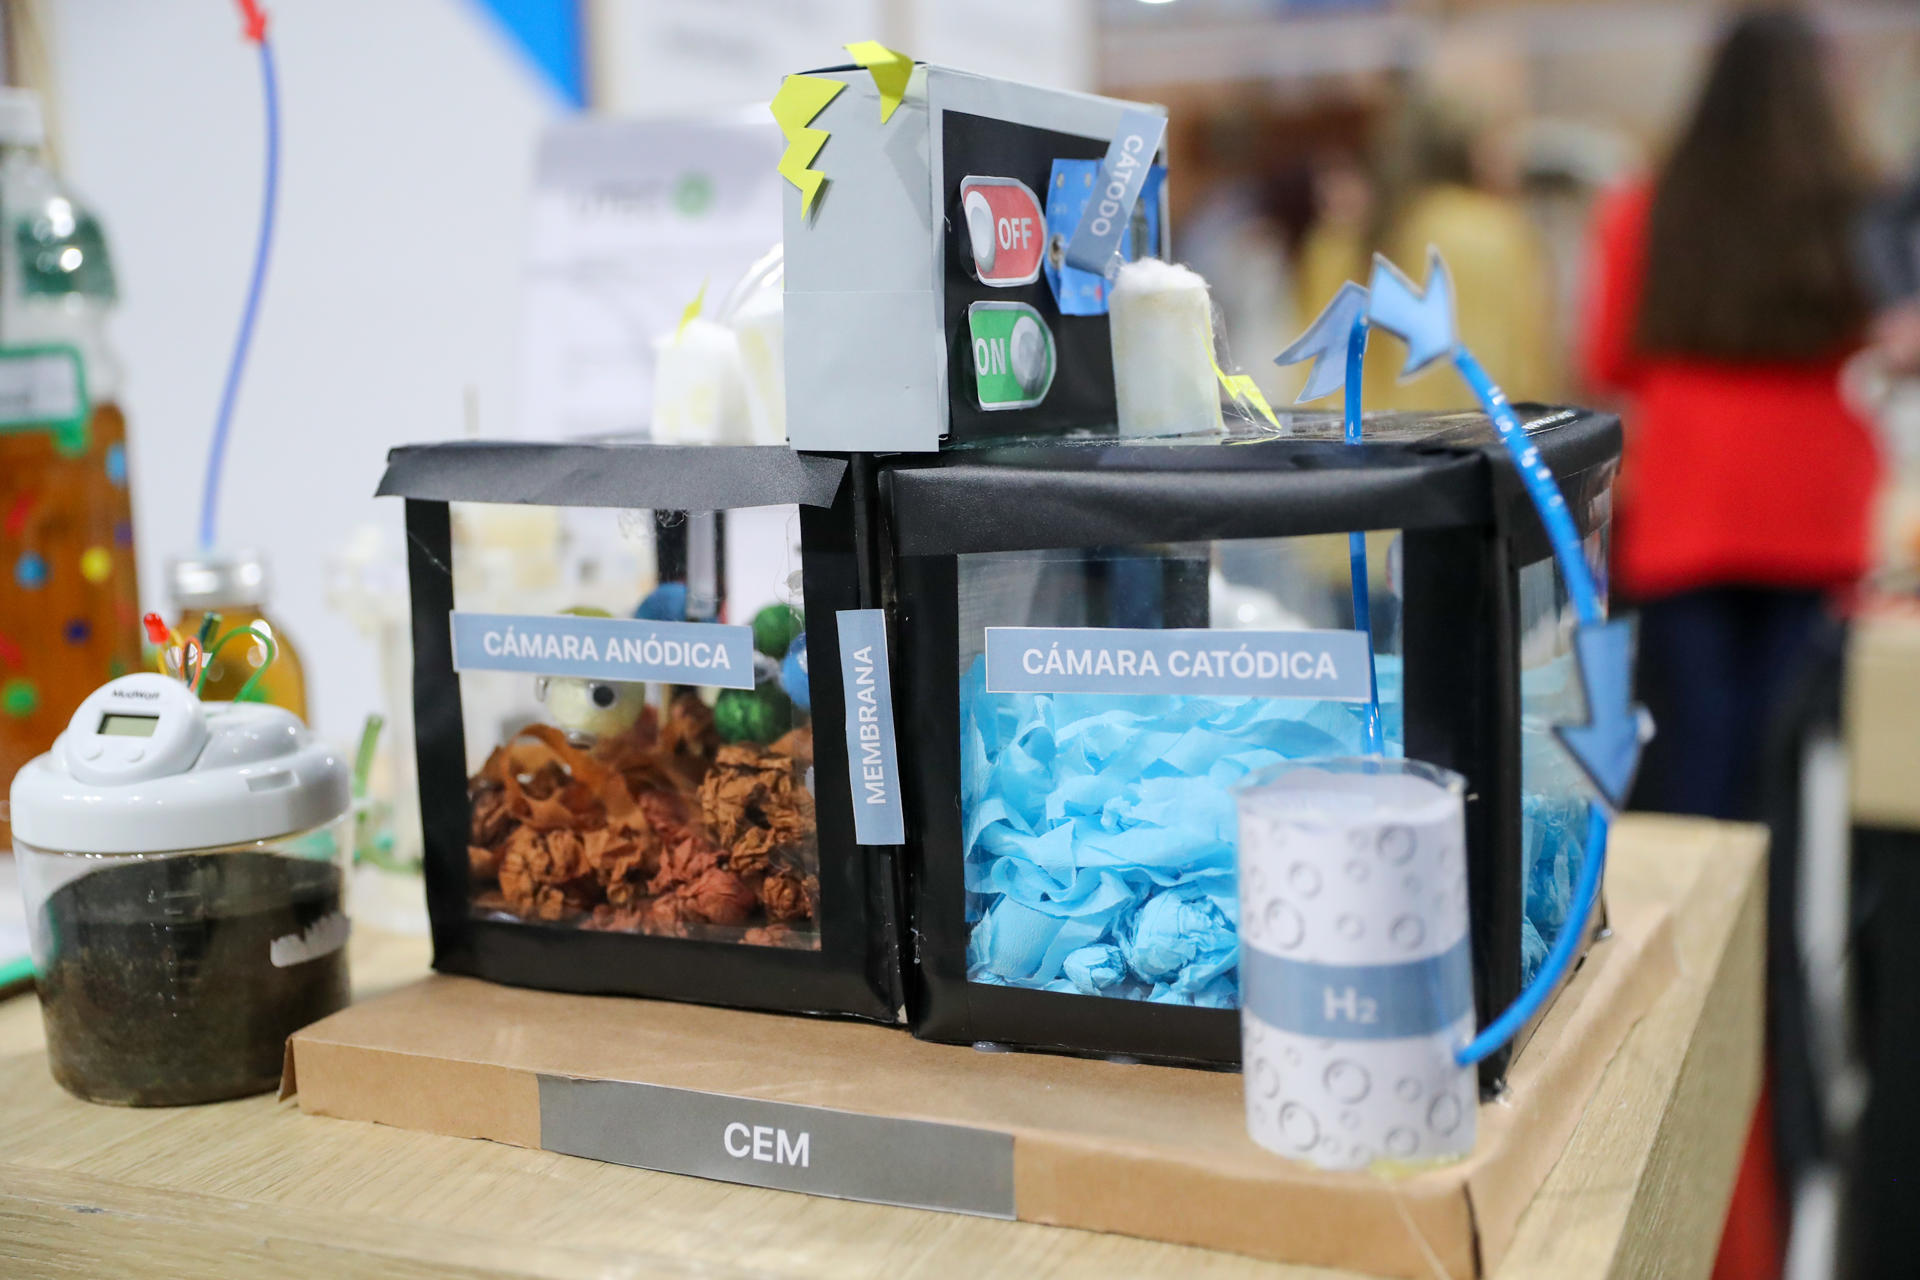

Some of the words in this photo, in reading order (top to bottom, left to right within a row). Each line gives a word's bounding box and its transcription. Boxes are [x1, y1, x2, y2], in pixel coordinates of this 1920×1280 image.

[1091, 134, 1144, 237] CÁTODO
[998, 217, 1033, 250] OFF
[975, 337, 1007, 376] ON
[483, 625, 599, 661] CÁMARA
[605, 633, 731, 670] ANÓDICA
[1022, 641, 1161, 676] CÁMARA
[1167, 643, 1338, 680] CATÓDICA
[853, 645, 887, 804] MEMBRANA
[724, 1122, 810, 1168] CEM
